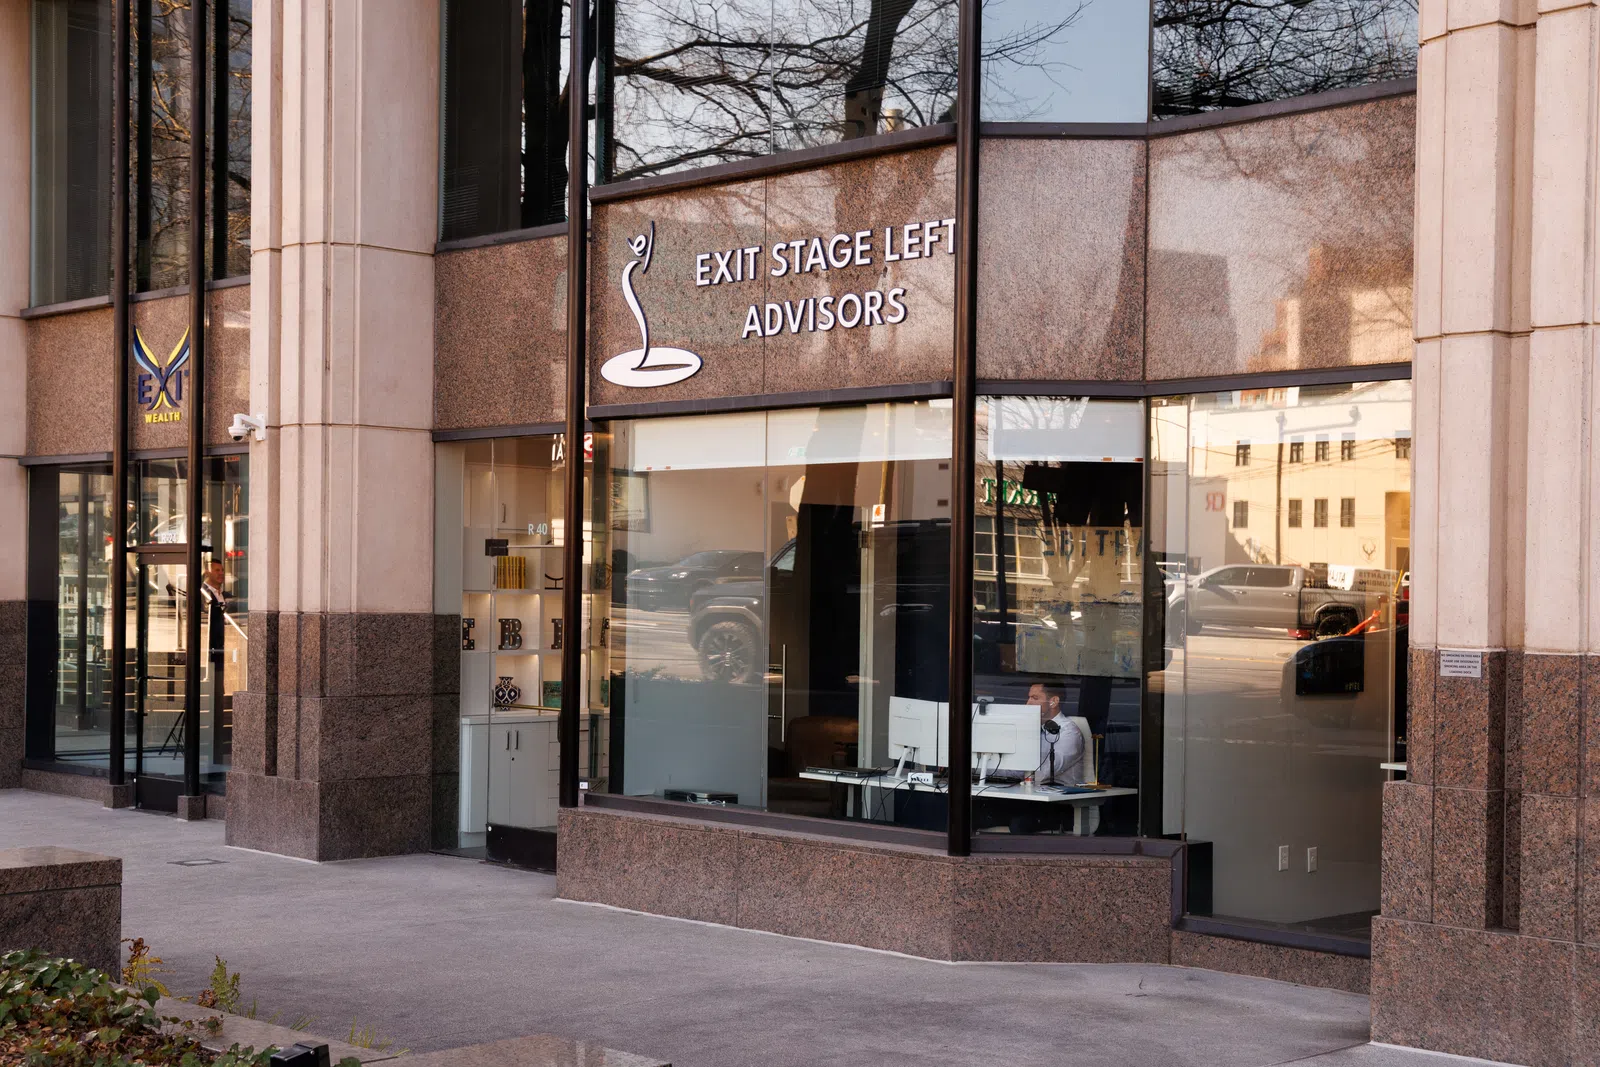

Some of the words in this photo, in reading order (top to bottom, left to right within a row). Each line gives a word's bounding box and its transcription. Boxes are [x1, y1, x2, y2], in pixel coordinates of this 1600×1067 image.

[695, 245, 761, 287] EXIT
[770, 229, 873, 277] STAGE
[884, 217, 956, 262] LEFT
[742, 287, 907, 339] ADVISORS
[145, 412, 180, 424] WEALTH
[528, 523, 535, 536] R
[536, 522, 548, 536] 40
